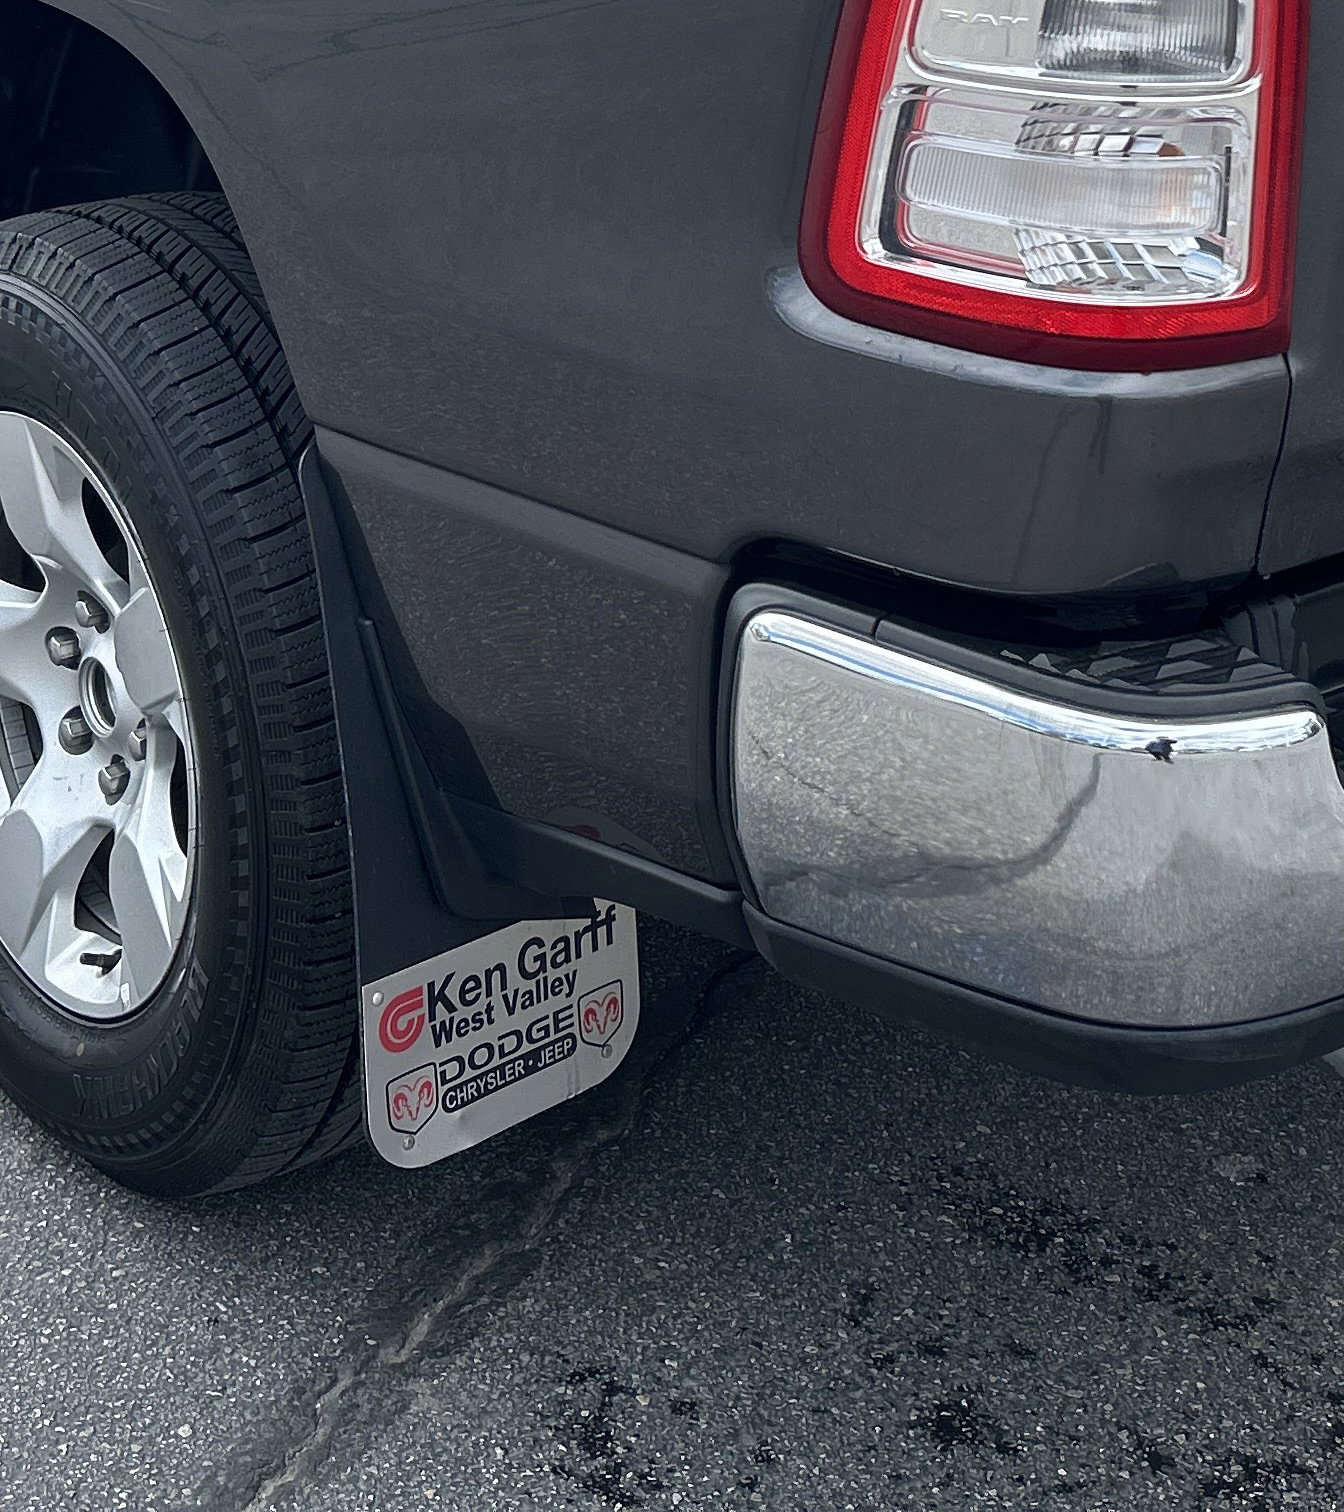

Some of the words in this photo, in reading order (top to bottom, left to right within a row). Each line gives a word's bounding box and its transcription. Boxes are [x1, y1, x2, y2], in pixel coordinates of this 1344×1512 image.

[427, 962, 506, 1023] Ken
[430, 1001, 495, 1049] West
[502, 968, 578, 1017] Valley
[439, 1004, 575, 1086] DODGE
[445, 1058, 526, 1110] CHRYSLER
[537, 1038, 573, 1069] JEEP
